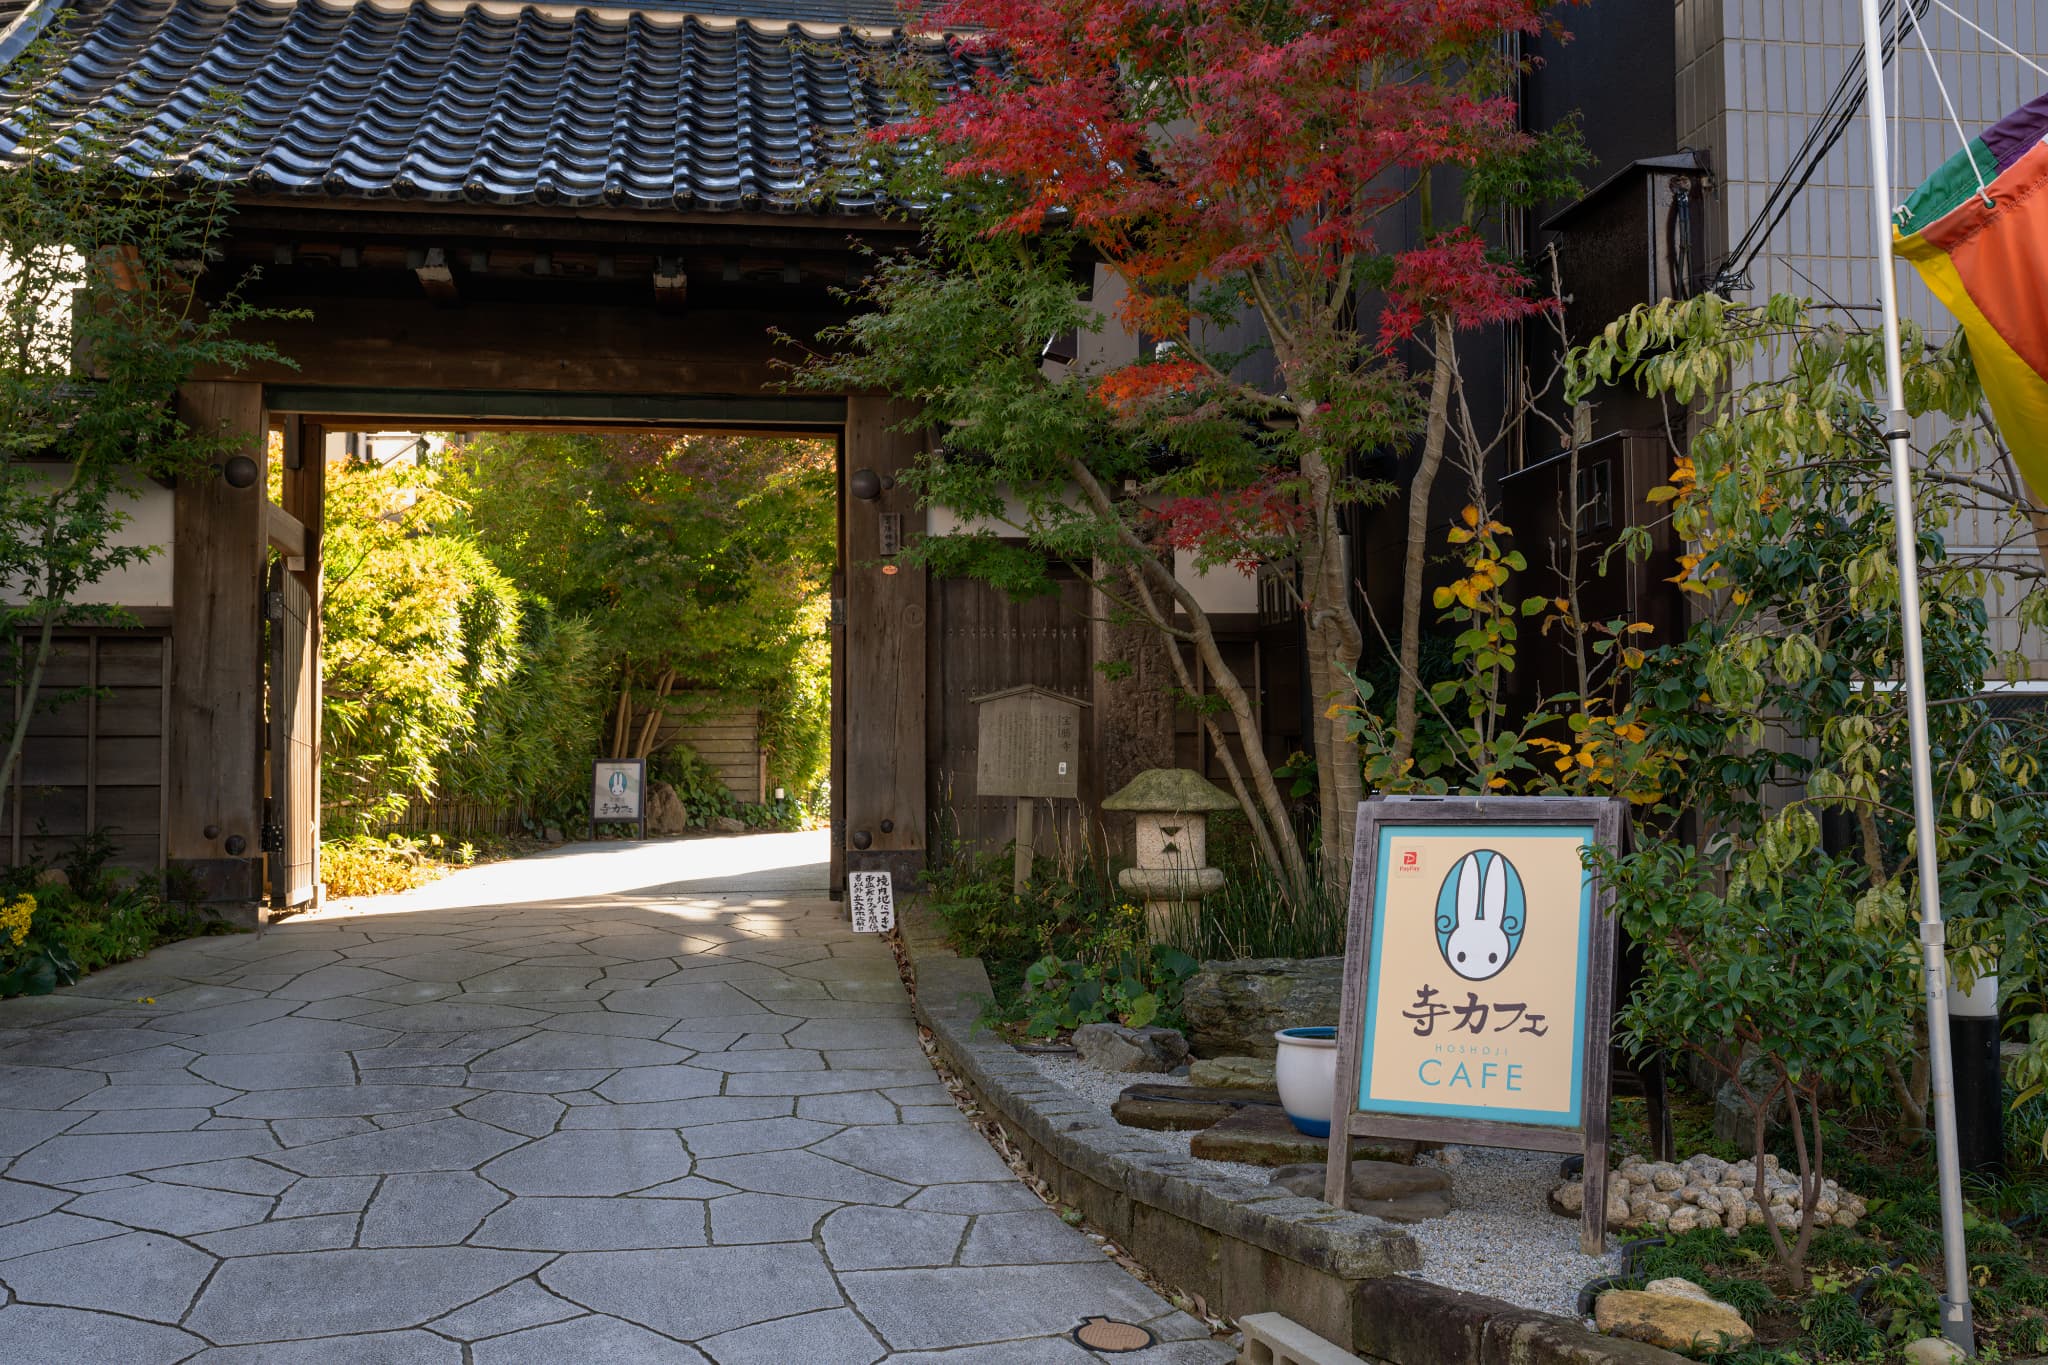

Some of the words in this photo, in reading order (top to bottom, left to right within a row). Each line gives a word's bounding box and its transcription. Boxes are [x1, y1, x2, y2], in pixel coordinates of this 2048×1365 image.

[876, 874, 891, 929] 境内地につき
[1402, 984, 1549, 1037] 寺カフェ
[1435, 1043, 1508, 1057] HOSHOJI
[1418, 1059, 1523, 1091] CAFE
